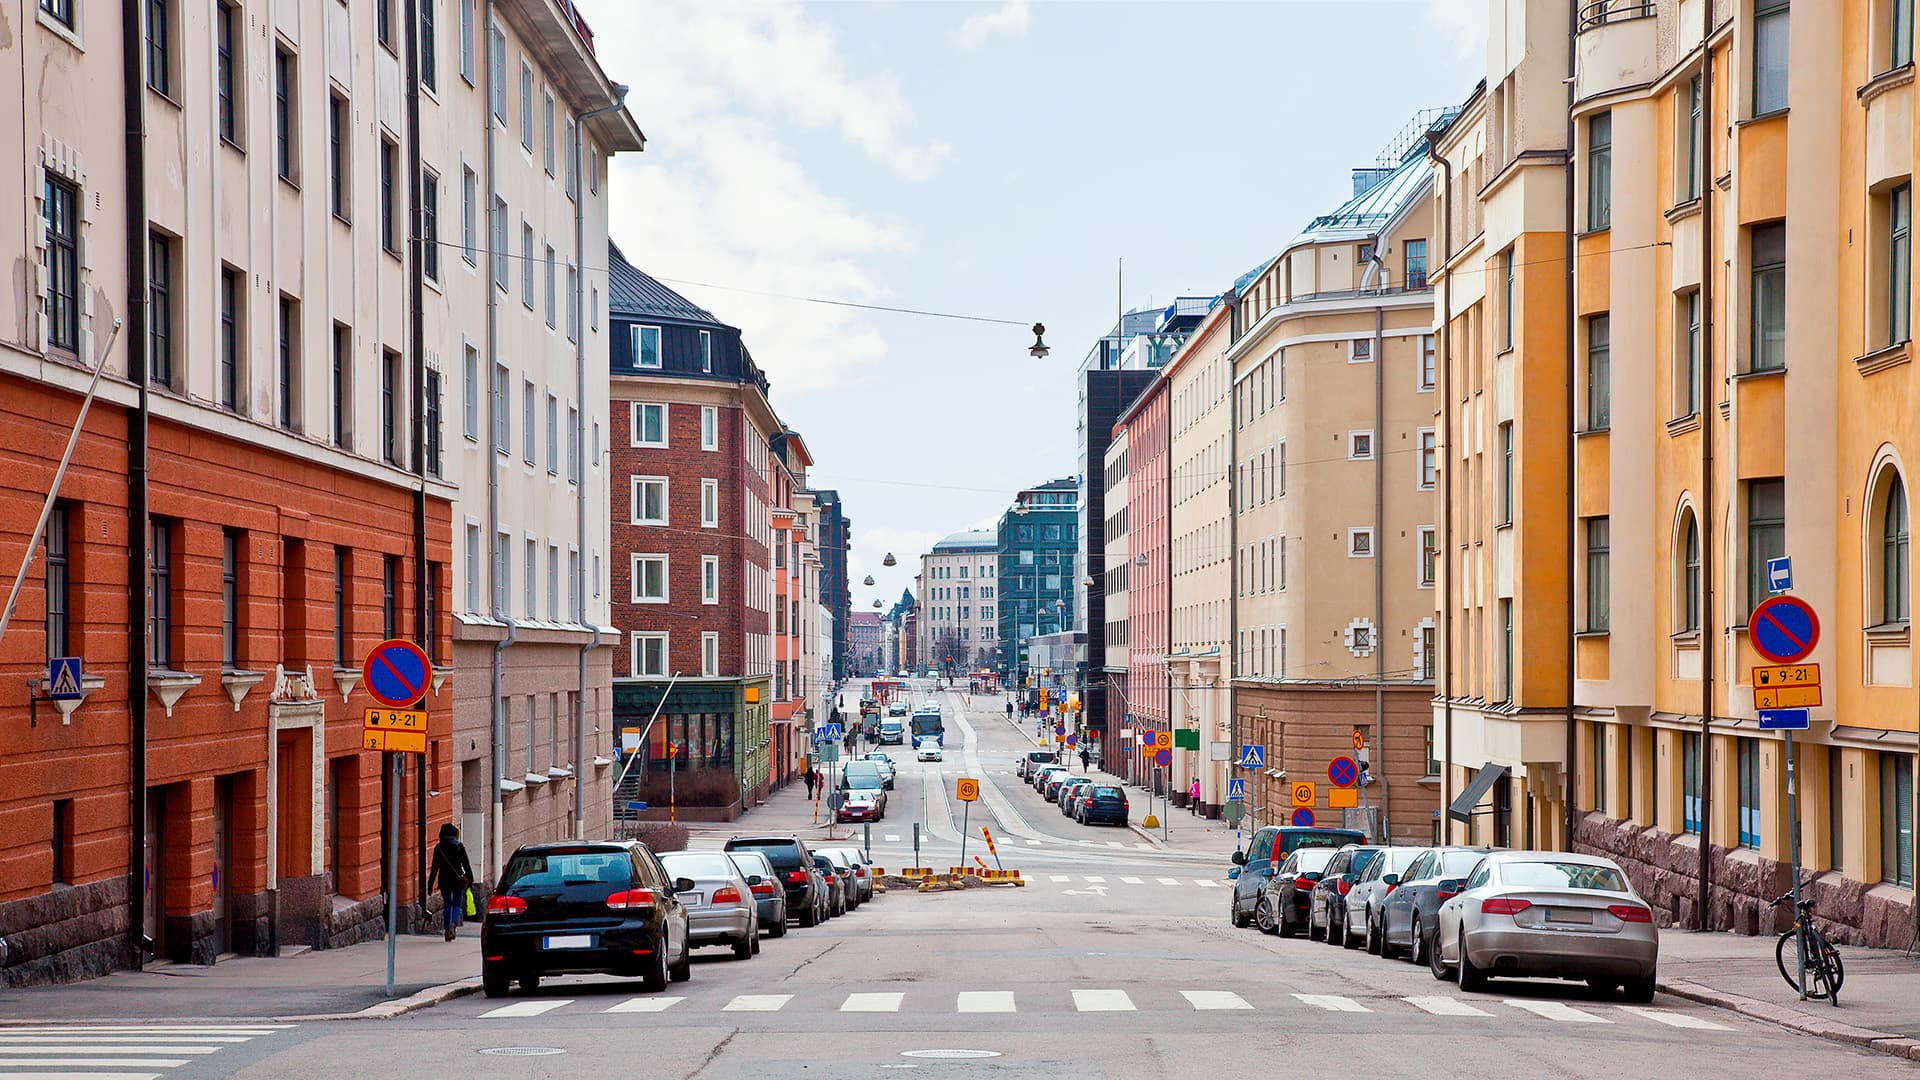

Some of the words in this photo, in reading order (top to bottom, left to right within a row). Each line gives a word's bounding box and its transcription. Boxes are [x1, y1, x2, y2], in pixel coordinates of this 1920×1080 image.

[370, 738, 377, 749] 2
[963, 785, 972, 793] 40
[1298, 789, 1309, 799] 40
